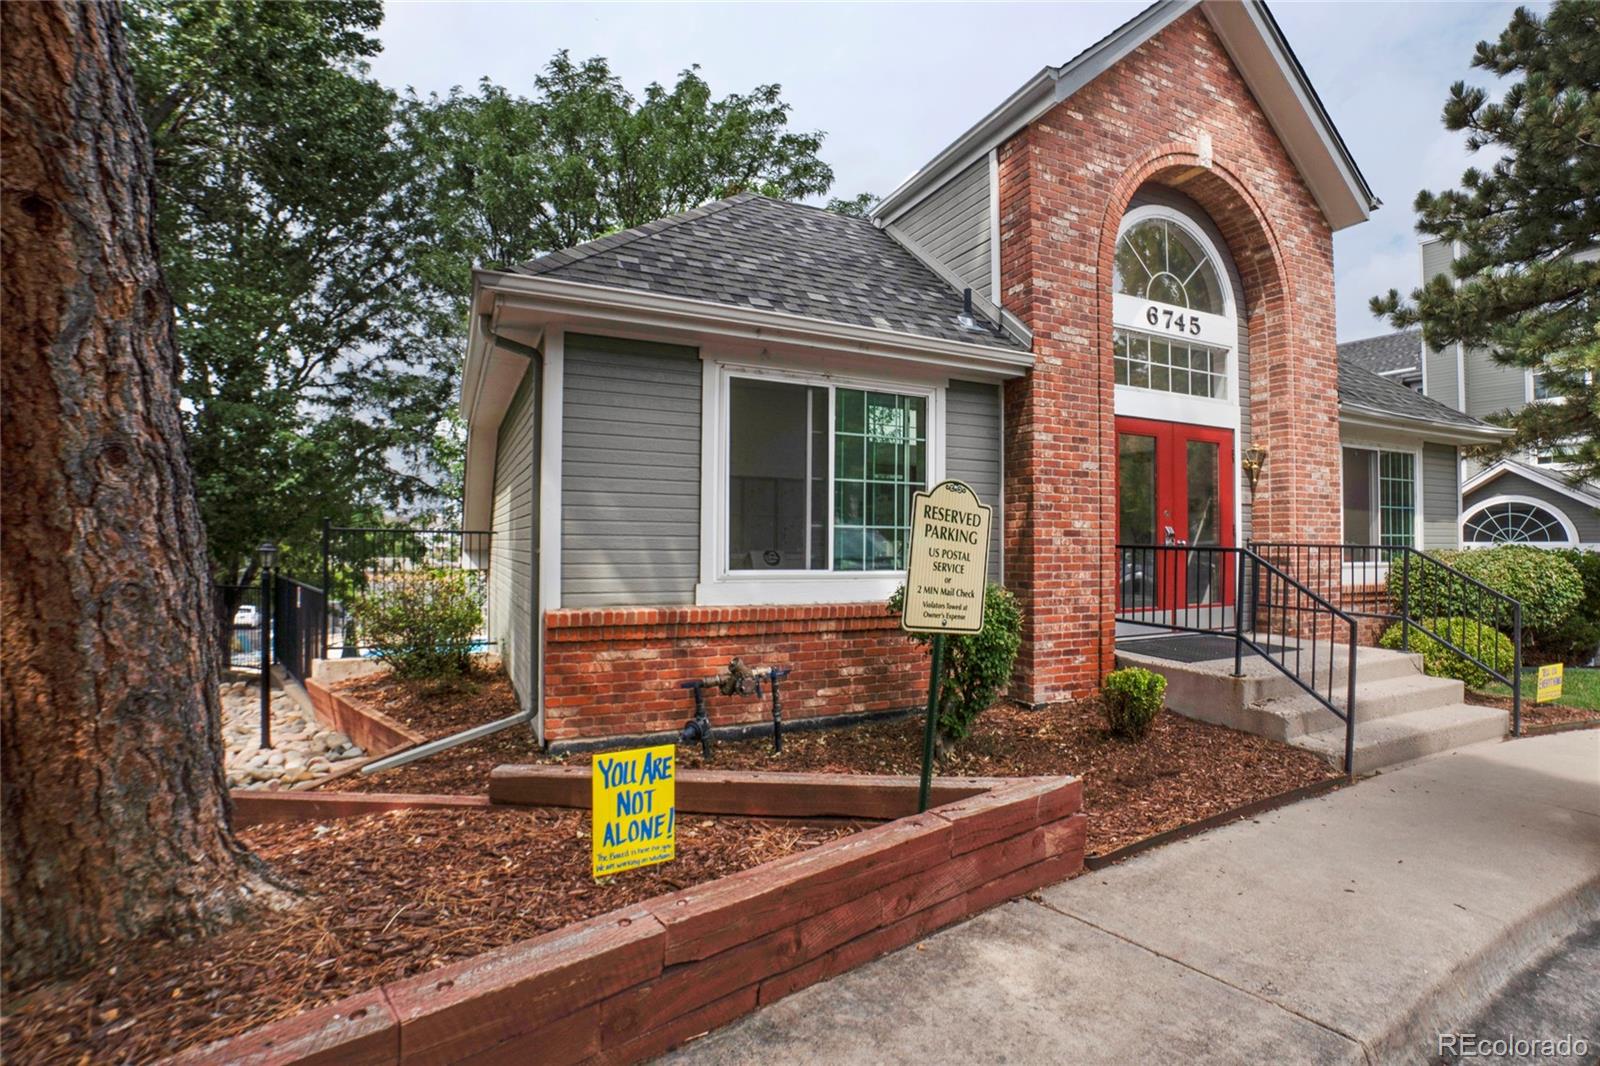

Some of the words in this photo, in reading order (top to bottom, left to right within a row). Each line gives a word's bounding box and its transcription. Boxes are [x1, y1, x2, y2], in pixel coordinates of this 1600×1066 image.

[1146, 305, 1201, 335] 6745
[923, 504, 982, 528] RESERVED
[924, 523, 978, 545] PARKING
[928, 547, 940, 558] US
[941, 549, 971, 562] POSTAL
[932, 561, 965, 575] SERVICE
[917, 585, 922, 594] 2
[923, 586, 939, 595] MIN
[940, 587, 955, 596] Mail
[956, 589, 975, 598] Check
[922, 600, 945, 609] Violators
[946, 602, 962, 610] Towed
[945, 612, 966, 621] Expense
[597, 758, 636, 789] YOU
[639, 752, 673, 786] ARE
[617, 789, 656, 818] NOT
[603, 806, 675, 848] ALONE!
